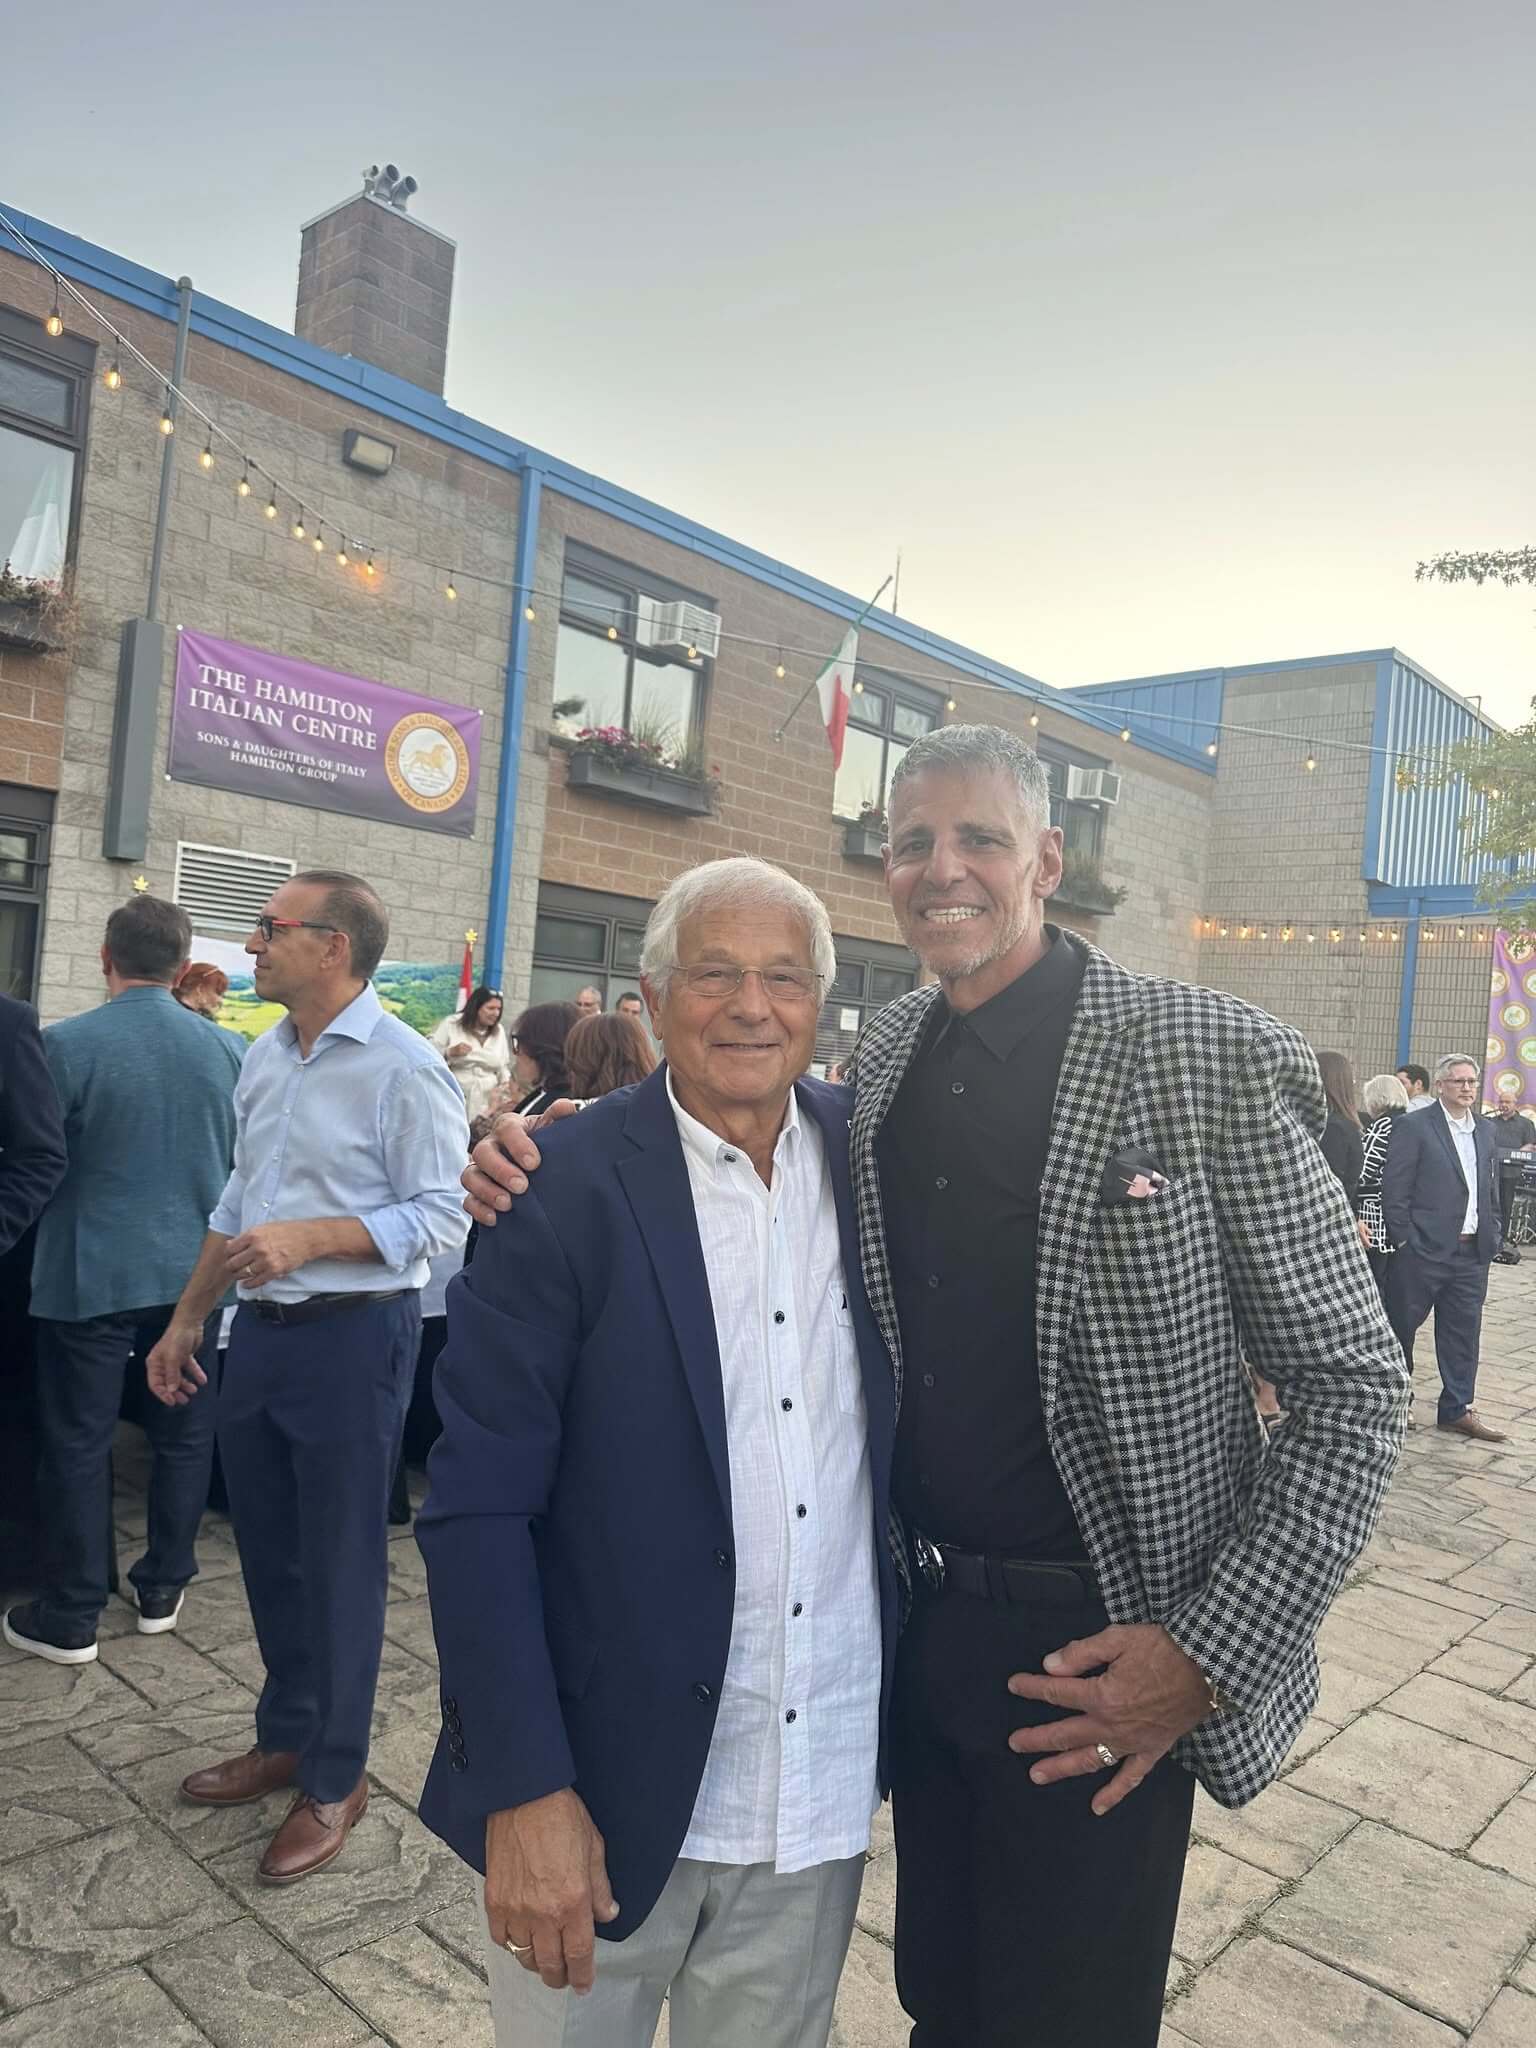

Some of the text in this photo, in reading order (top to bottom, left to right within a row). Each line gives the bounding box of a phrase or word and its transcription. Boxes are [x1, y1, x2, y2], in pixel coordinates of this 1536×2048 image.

[199, 664, 373, 725] THE HAMILTON
[189, 688, 376, 750] ITALIAN CENTRE
[197, 731, 368, 779] SONS & DAUGHTERS OF ITALY
[230, 751, 338, 783] HAMILTON GROUP
[414, 796, 452, 809] CANADA
